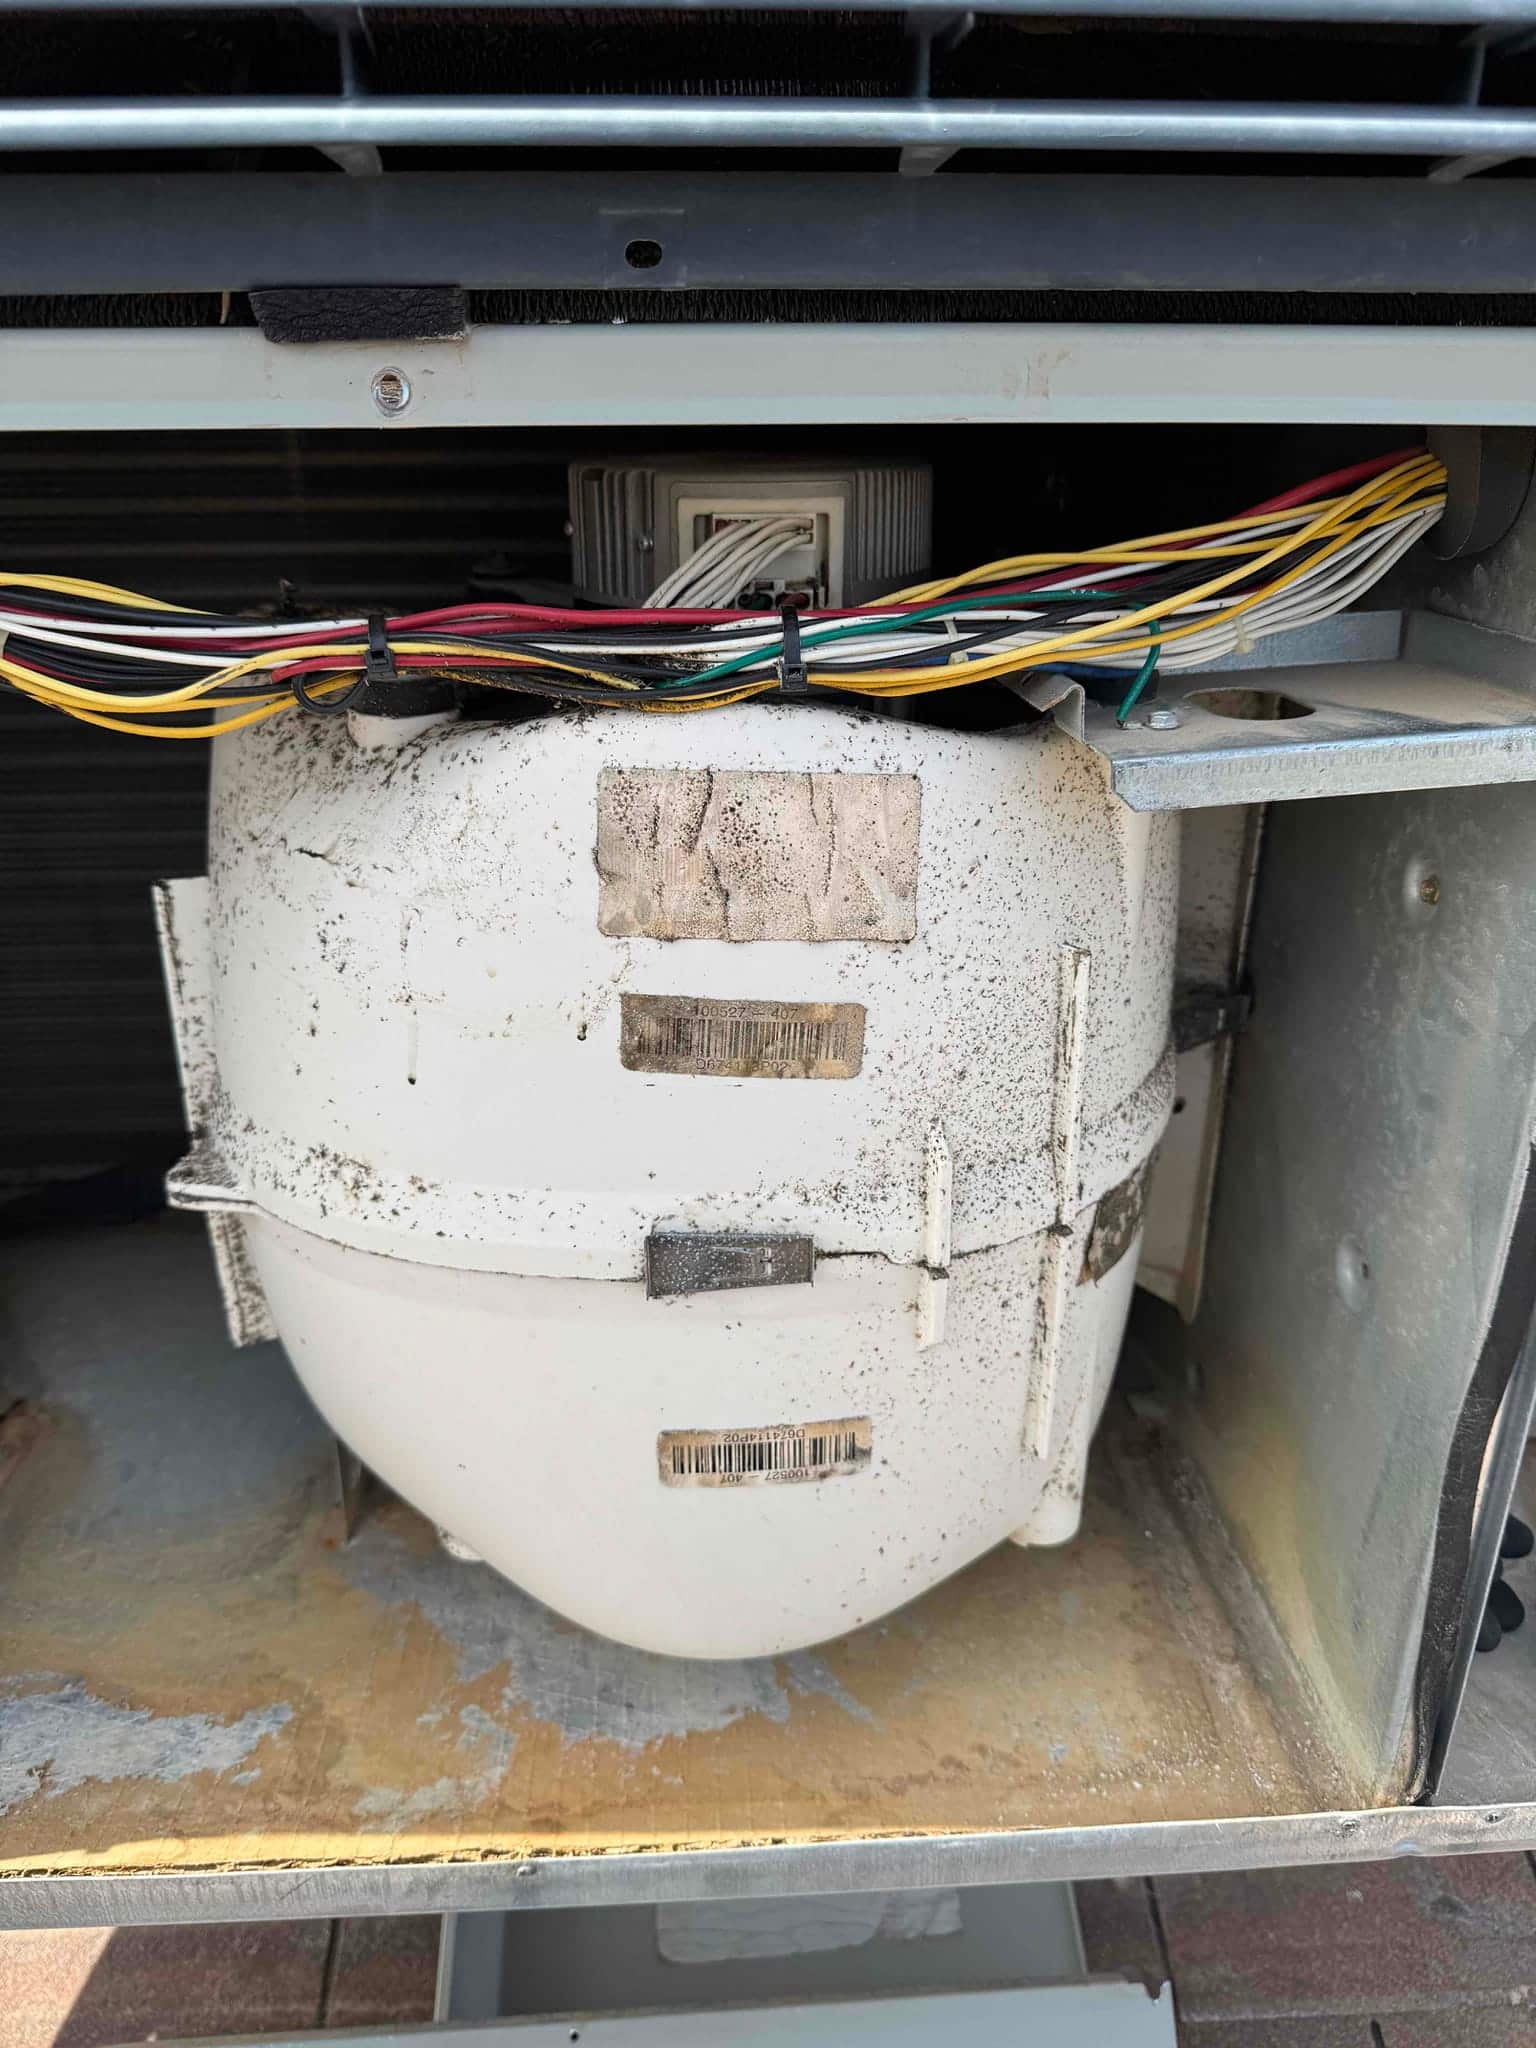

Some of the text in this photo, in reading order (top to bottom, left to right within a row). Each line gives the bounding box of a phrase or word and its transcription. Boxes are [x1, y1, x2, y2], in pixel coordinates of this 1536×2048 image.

[695, 1005, 746, 1018] 100527
[771, 1007, 801, 1020] 407
[723, 1429, 805, 1443] D674114P02
[720, 1474, 743, 1484] 407
[764, 1469, 809, 1481] 100527
